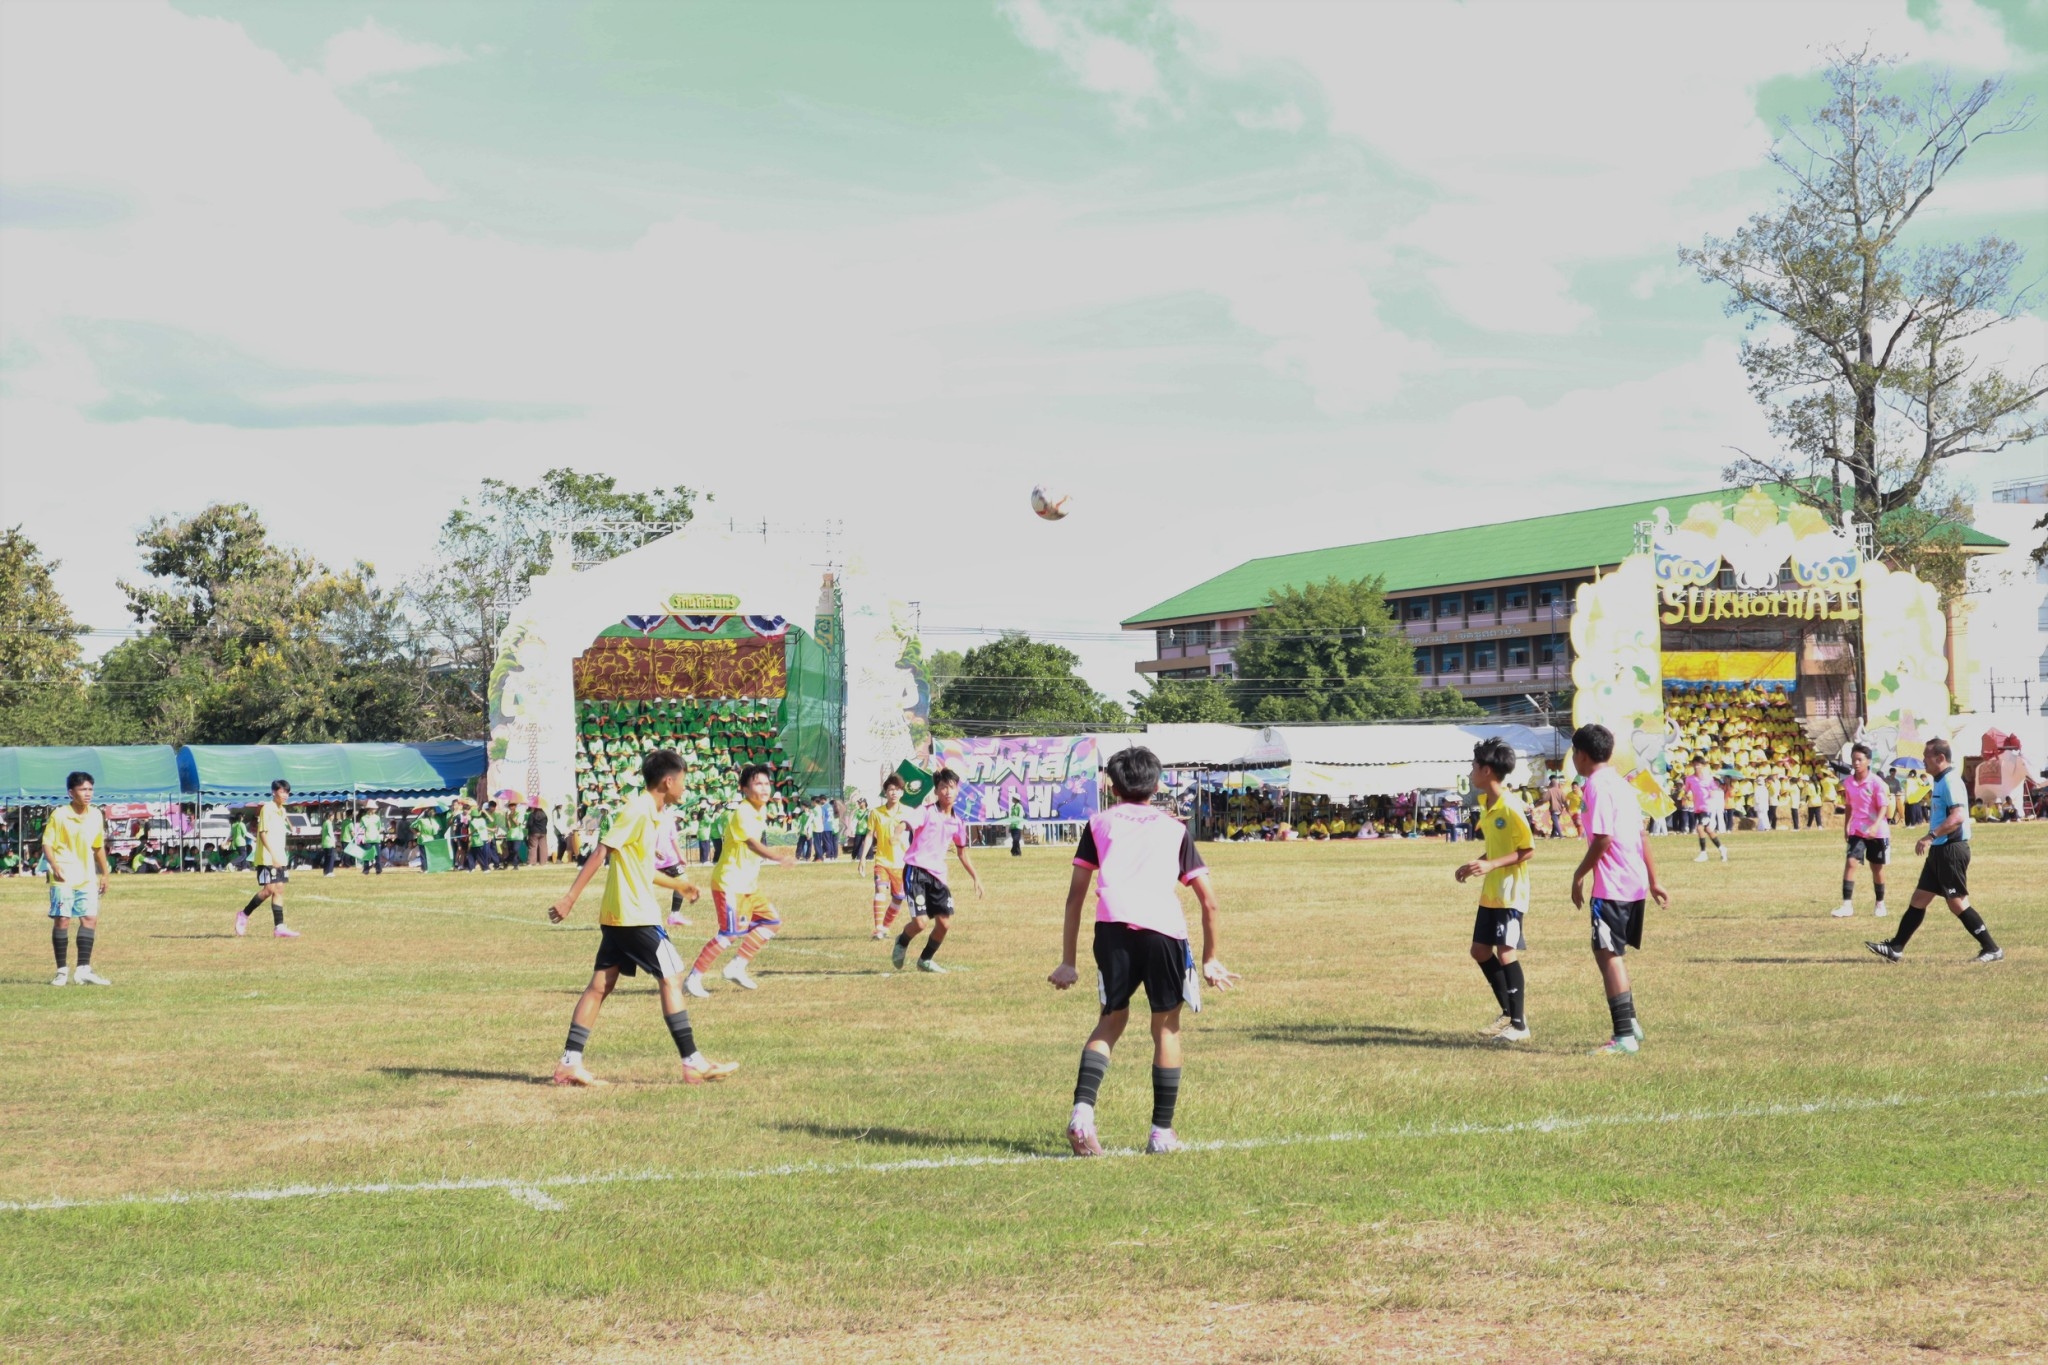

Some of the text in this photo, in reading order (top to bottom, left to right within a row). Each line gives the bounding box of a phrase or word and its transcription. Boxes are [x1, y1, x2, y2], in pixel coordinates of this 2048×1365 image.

[1660, 583, 1860, 625] SUKHOTHAI
[968, 741, 1072, 784] กีฬาสี
